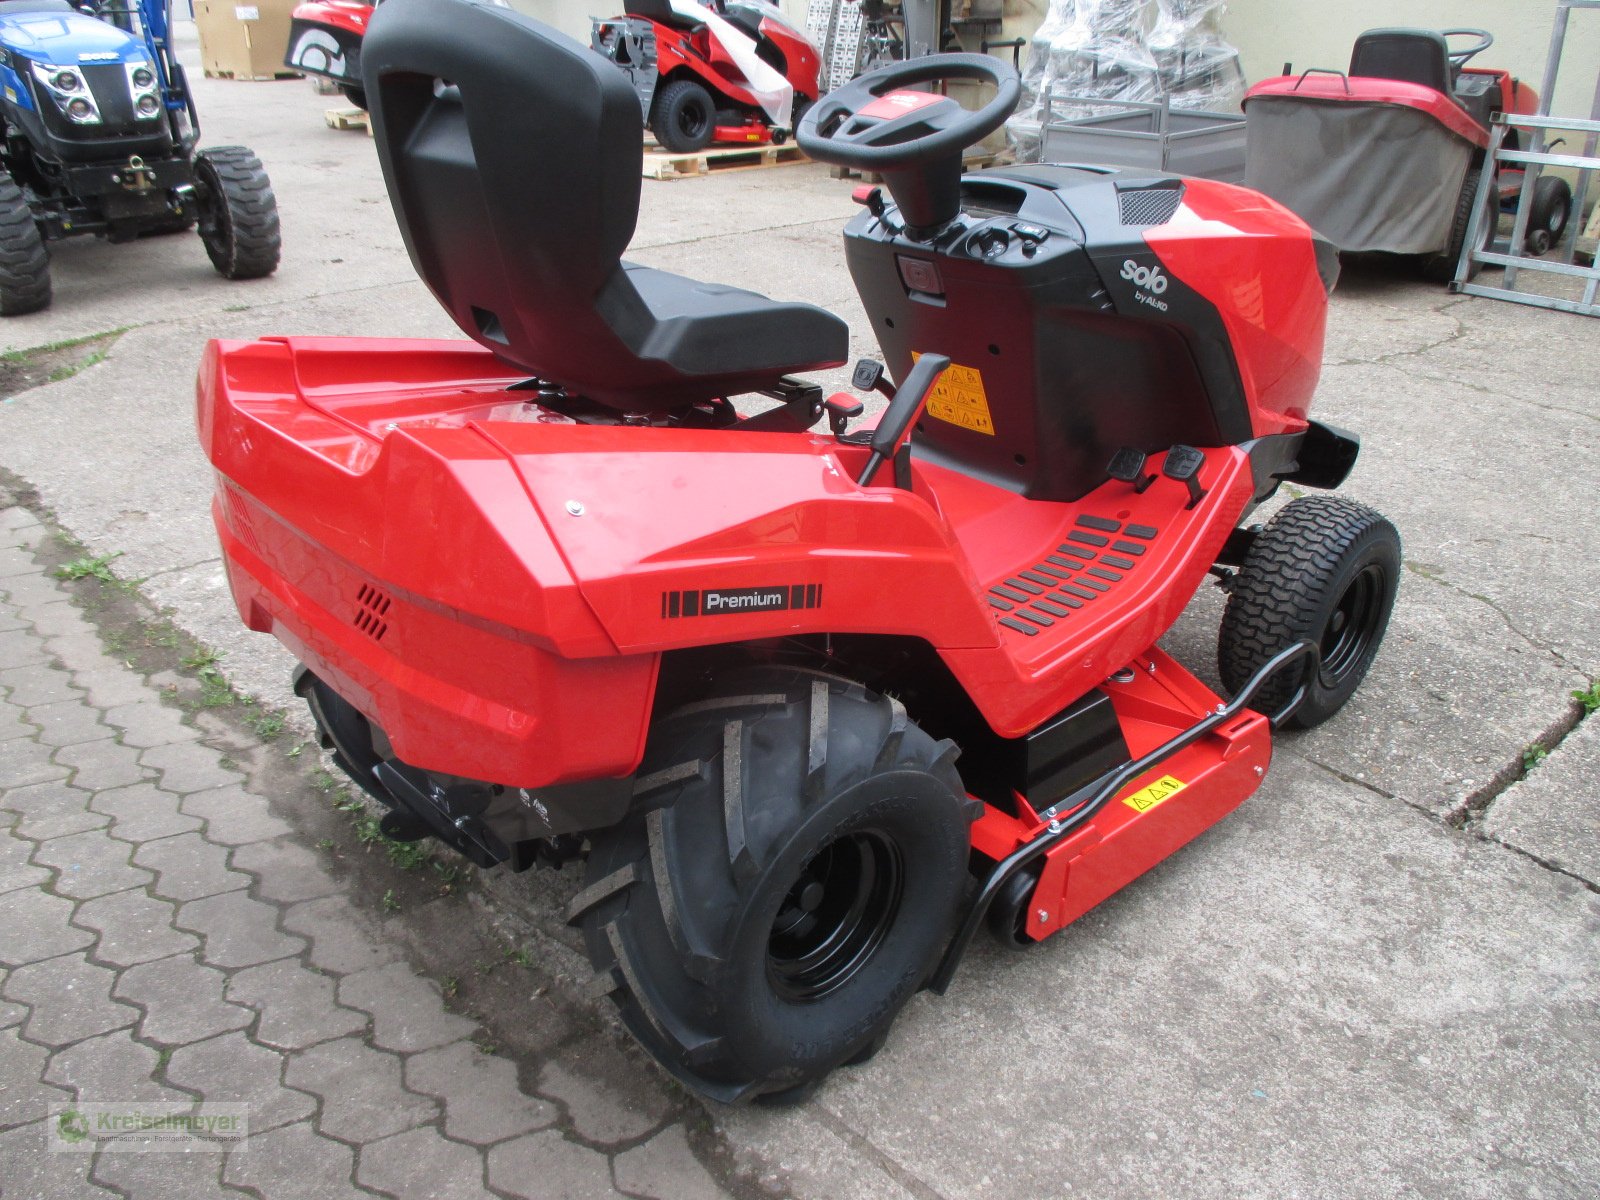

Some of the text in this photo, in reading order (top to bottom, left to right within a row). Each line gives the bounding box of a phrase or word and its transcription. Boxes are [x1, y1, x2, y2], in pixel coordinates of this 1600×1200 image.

[1120, 259, 1168, 295] Solo
[1134, 290, 1147, 304] by
[706, 591, 782, 610] Premium
